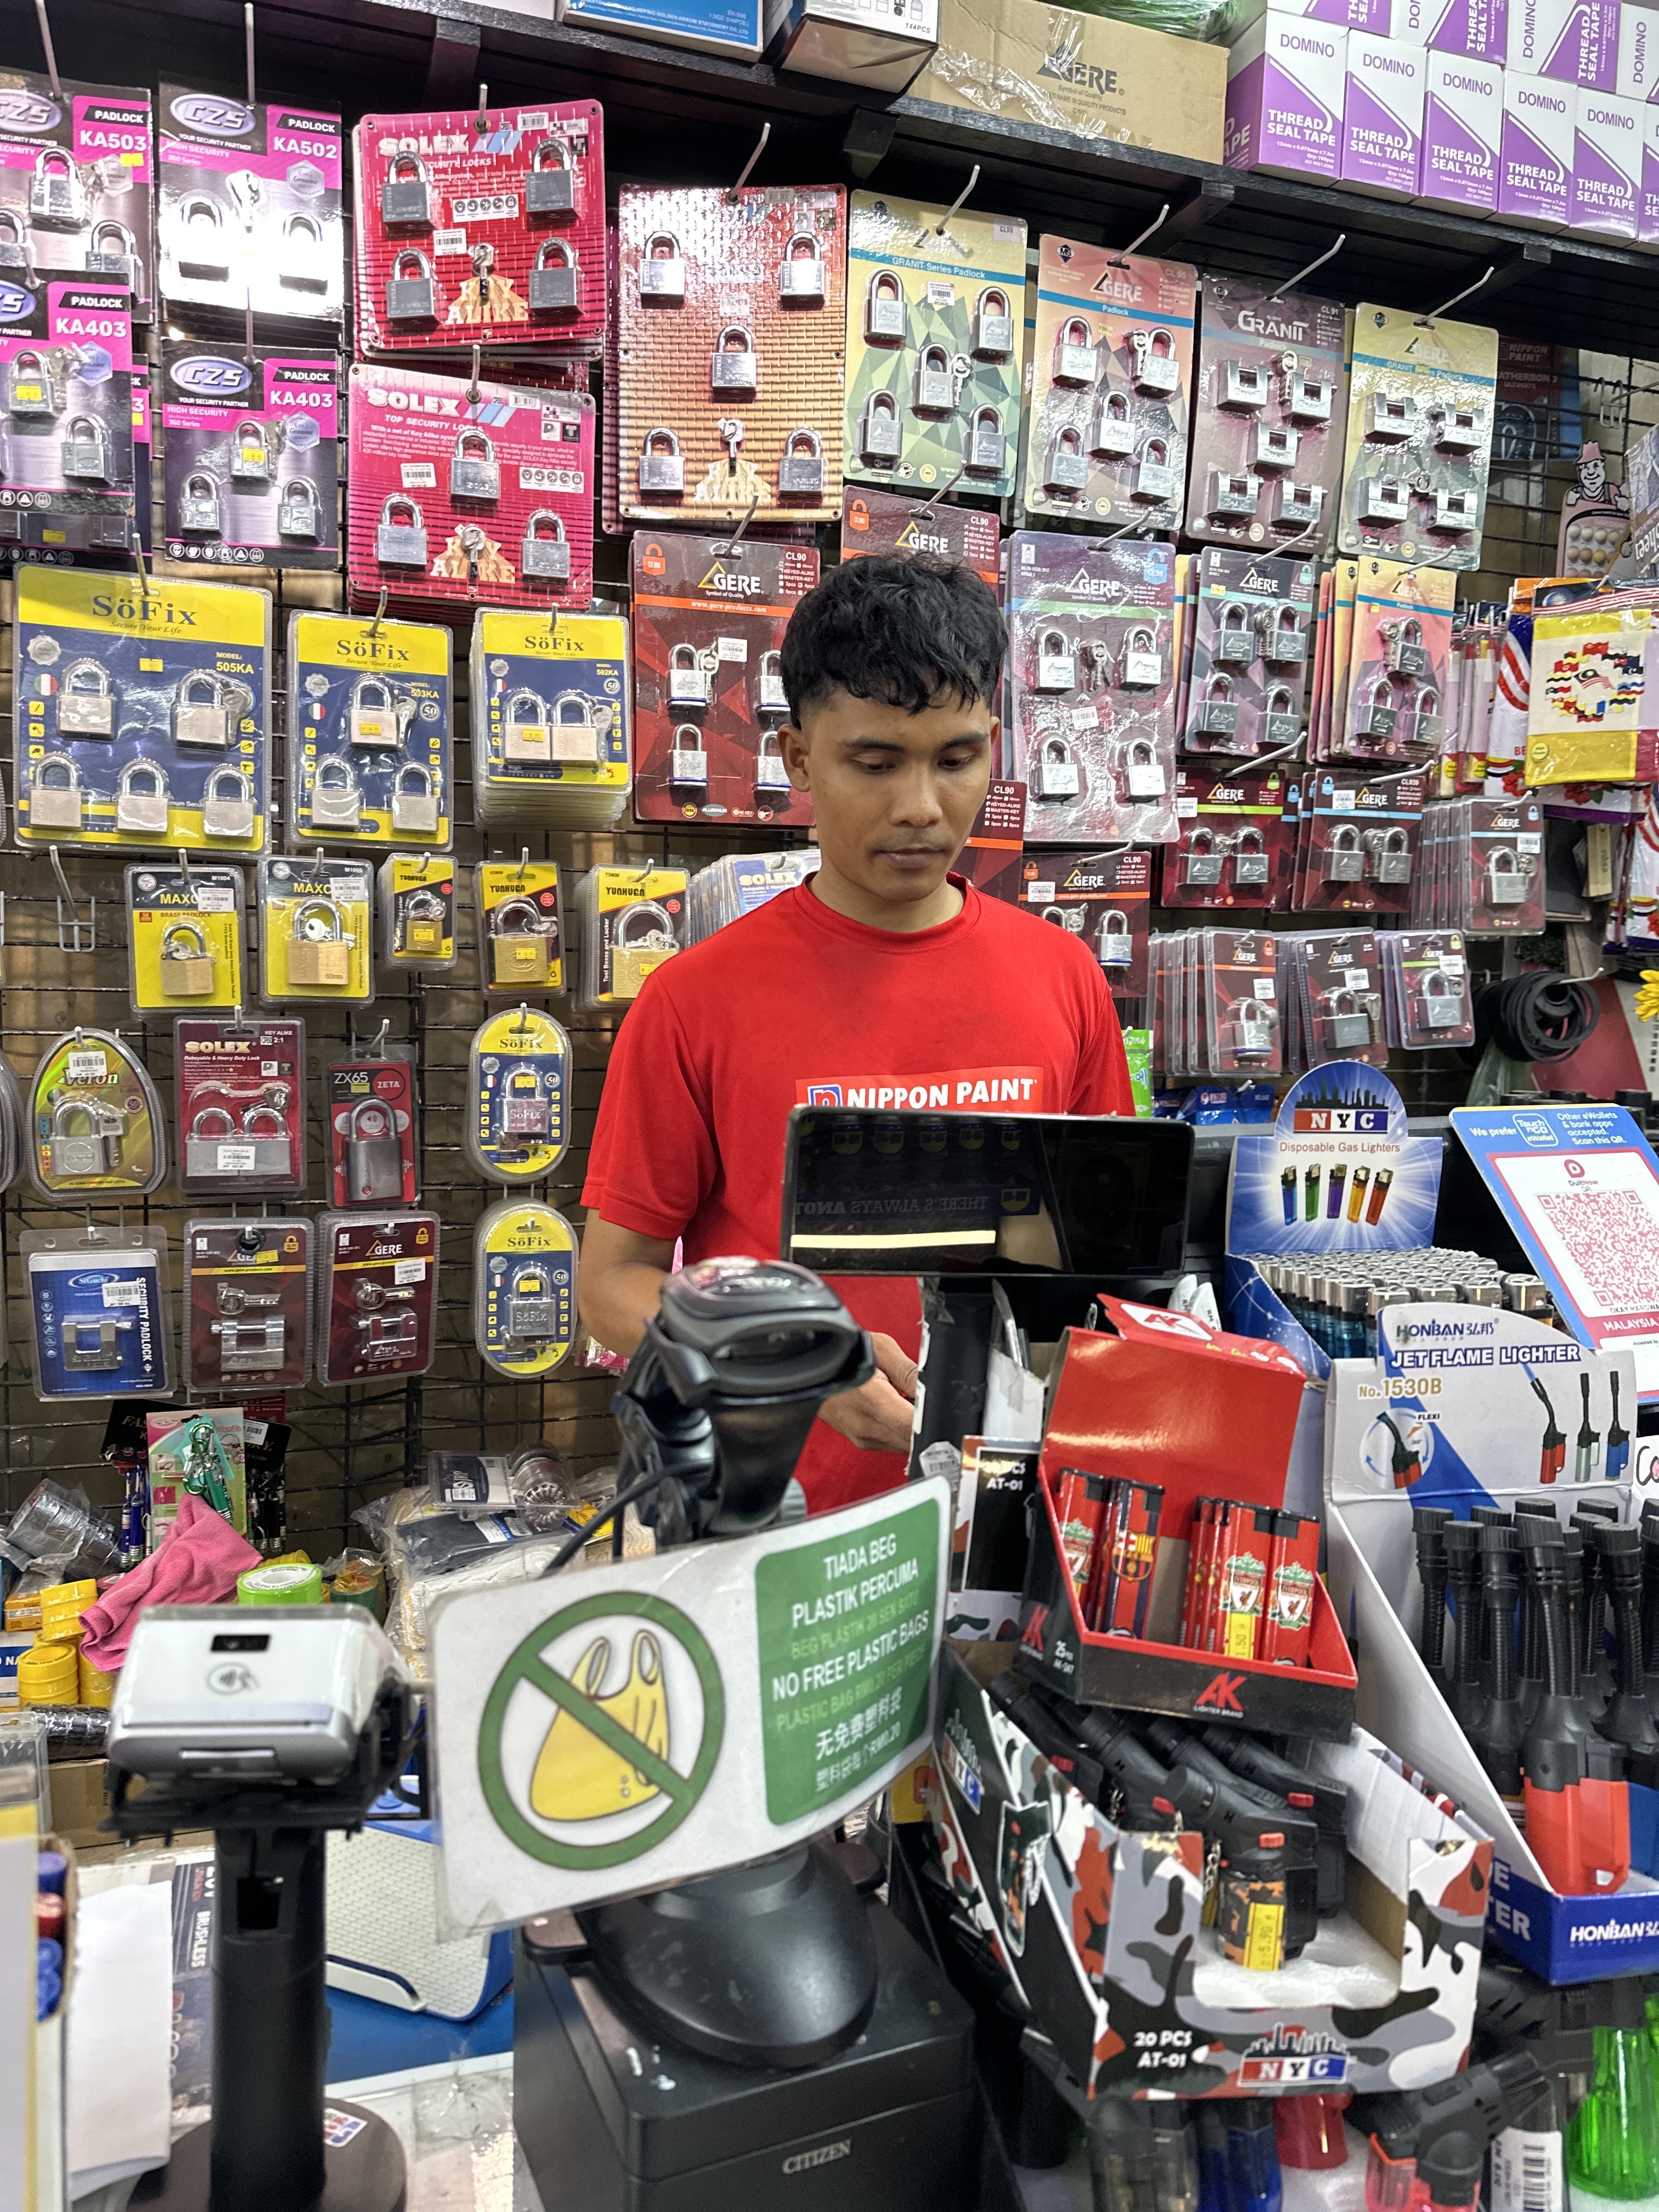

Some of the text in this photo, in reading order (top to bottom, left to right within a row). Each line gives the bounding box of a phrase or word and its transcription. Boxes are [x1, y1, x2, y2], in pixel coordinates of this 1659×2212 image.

[905, 22, 931, 34] 144PCS
[1280, 33, 1335, 58] DOMINO
[1588, 2, 1600, 82] SEAL TAPE
[1633, 21, 1647, 83] DOMINO
[1363, 53, 1415, 77] DOMINO
[1443, 73, 1493, 96] DOMINO
[1518, 91, 1566, 114] DOMINO
[94, 110, 144, 123] PADLOCK
[184, 104, 246, 129] CZS
[1268, 109, 1323, 131] THREAD
[1587, 109, 1634, 130] DOMINO
[288, 119, 335, 133] PADLOCK
[1267, 122, 1336, 146] SEAL TAPE
[80, 130, 147, 151] KA503
[379, 134, 470, 157] SOLEX
[1351, 127, 1403, 148] THREAD
[274, 137, 338, 159] KA502
[1350, 140, 1415, 164] SEAL TAPE
[1432, 145, 1482, 165] THREAD
[1431, 158, 1494, 180] SEAL TAPE
[1507, 162, 1556, 181] THREAD
[1506, 174, 1567, 196] SEAL TAPE
[1577, 178, 1624, 198] THREAD
[1576, 190, 1605, 205] SEAL
[1607, 195, 1635, 212] TAPE
[893, 257, 985, 279] GRANIT Series Padlock
[1102, 279, 1143, 303] GERE
[71, 296, 123, 309] PADLOCK
[1103, 304, 1129, 317] Padlock
[445, 302, 529, 325] ALIKE
[56, 317, 127, 338] KA403
[1238, 310, 1310, 342] GRANIT
[1509, 343, 1548, 354] NIPPON
[1509, 352, 1541, 363] PAINT
[184, 368, 244, 387] CZS
[285, 371, 329, 382] PADLOCK
[195, 398, 222, 407] SECURITY
[270, 391, 334, 408] KA403
[367, 388, 461, 418] SOLEX
[167, 407, 228, 417] HIGH SECURITY
[385, 414, 450, 430] TOP SECURITY
[970, 516, 989, 526] CL90
[909, 532, 949, 554] GERE
[786, 551, 806, 561] CL90
[714, 573, 761, 596] GERE
[1079, 577, 1121, 599] GERE
[92, 595, 198, 626] SöFix
[691, 601, 766, 613] www.gere-products.com
[110, 620, 182, 634] Secure Your Life
[336, 639, 410, 662] SöFix
[524, 635, 585, 652] SöFix
[216, 662, 254, 674] 505KA
[411, 689, 439, 699] 503KA
[606, 682, 618, 690] 50
[994, 786, 1014, 794] CL90
[1216, 788, 1244, 803] GERE
[1362, 792, 1388, 807] GERE
[1496, 817, 1521, 828] GERE
[739, 871, 797, 886] SOLEX
[1073, 876, 1104, 888] GERE
[294, 882, 331, 894] MAXC
[160, 894, 198, 905] MAXC
[1237, 951, 1257, 963] GERE
[185, 1041, 251, 1053] SOLEX
[499, 1037, 543, 1050] SöFix
[334, 1071, 369, 1085] ZX65
[377, 1081, 400, 1089] ZETA
[546, 1075, 558, 1086] 50
[847, 1078, 1034, 1109] NIPPON PAINT
[1309, 1111, 1376, 1130] NYC
[1517, 1119, 1545, 1127] Touch
[1557, 1111, 1618, 1120] Other eWallets
[1470, 1127, 1517, 1138] We prefer
[1567, 1127, 1610, 1138] accepted.
[1572, 1120, 1592, 1128] bank
[1593, 1120, 1614, 1130] apps
[1279, 1141, 1401, 1154] Disposable Gas Lighters
[374, 1243, 403, 1256] GERE
[507, 1235, 551, 1248] SöFix
[1610, 1304, 1659, 1314] OKAY HARDWA
[136, 1277, 154, 1362] SECURITY PADLOCK
[1603, 1317, 1658, 1332] MALAYSIA
[1390, 1344, 1581, 1368] JET FLAME LIGHTER
[1418, 1412, 1441, 1421] FLEXI
[986, 1477, 1023, 1491] AT-01
[823, 1533, 898, 1581] TIADA BEG
[792, 1557, 919, 1628] PLASTIK PERCUMA
[772, 1609, 930, 1702] NO FREE PLASTIC BAGS
[792, 1635, 819, 1661] BEG
[777, 1689, 854, 1733] PLASTIC BAG
[1194, 1705, 1244, 1719] LIGHTER BRAND
[191, 1910, 212, 1969] BRUSHLESS
[1134, 2030, 1193, 2049] 20 PCS
[1137, 2050, 1187, 2069] AT-01
[1260, 2057, 1331, 2080] NYC
[781, 2140, 854, 2175] CITIZEN
